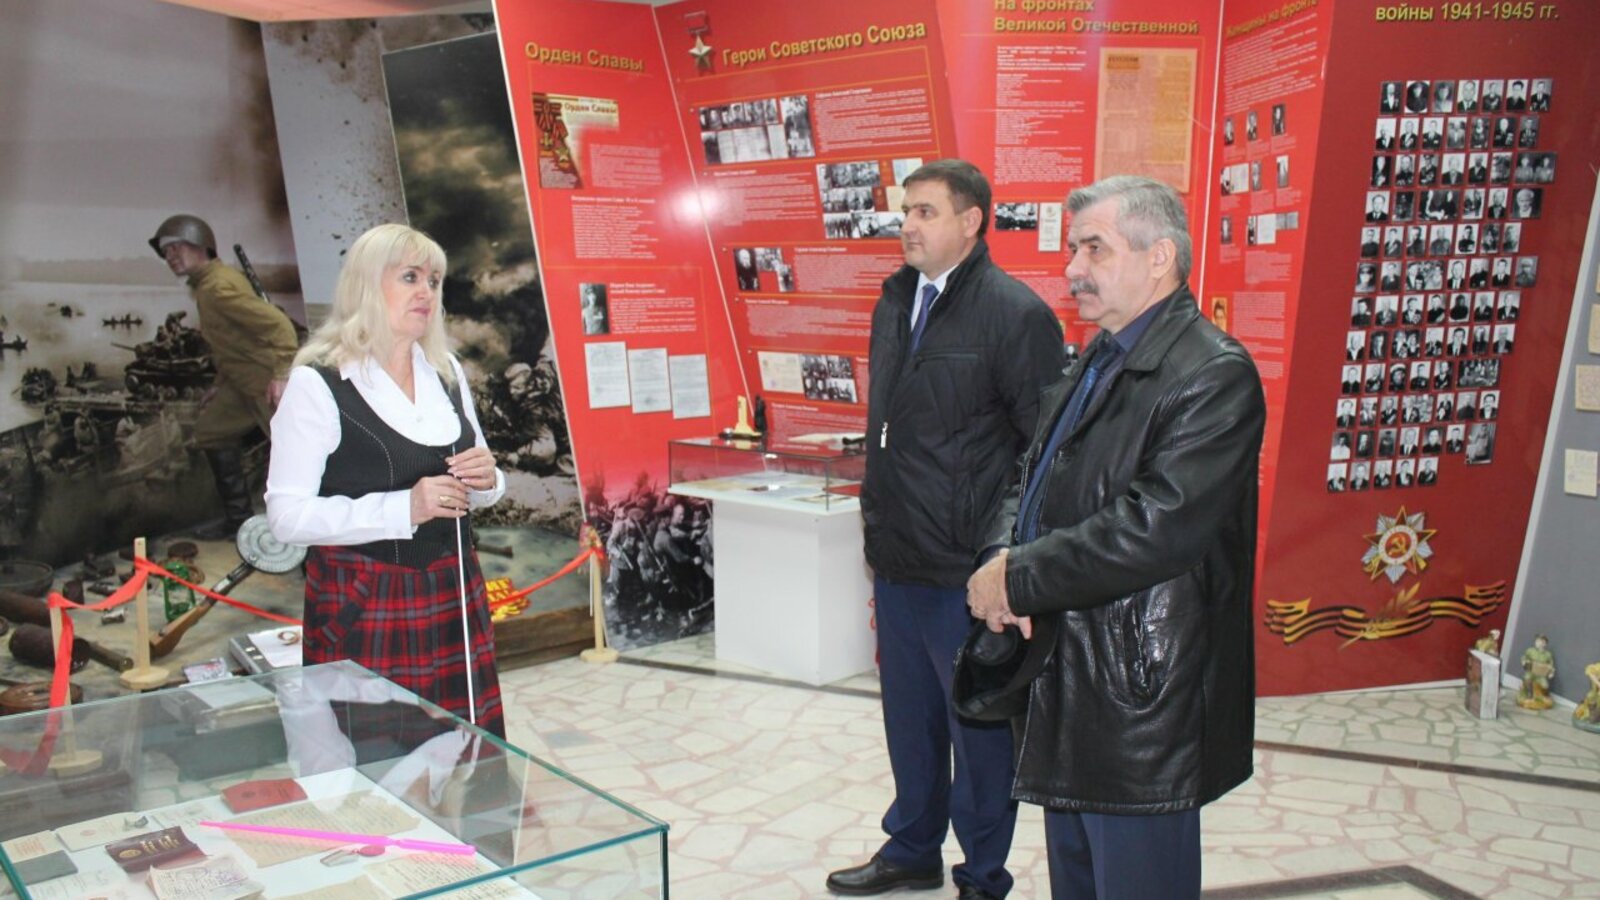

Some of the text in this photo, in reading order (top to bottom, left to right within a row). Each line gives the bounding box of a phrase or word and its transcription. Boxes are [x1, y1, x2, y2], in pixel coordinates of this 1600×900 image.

[994, 0, 1094, 15] На фронтах
[1375, 1, 1559, 21] войны 1941-1945 гг.
[994, 16, 1198, 34] Великой Отечественной
[722, 22, 926, 67] Герои Советского Союза
[525, 41, 643, 71] Орден Славы
